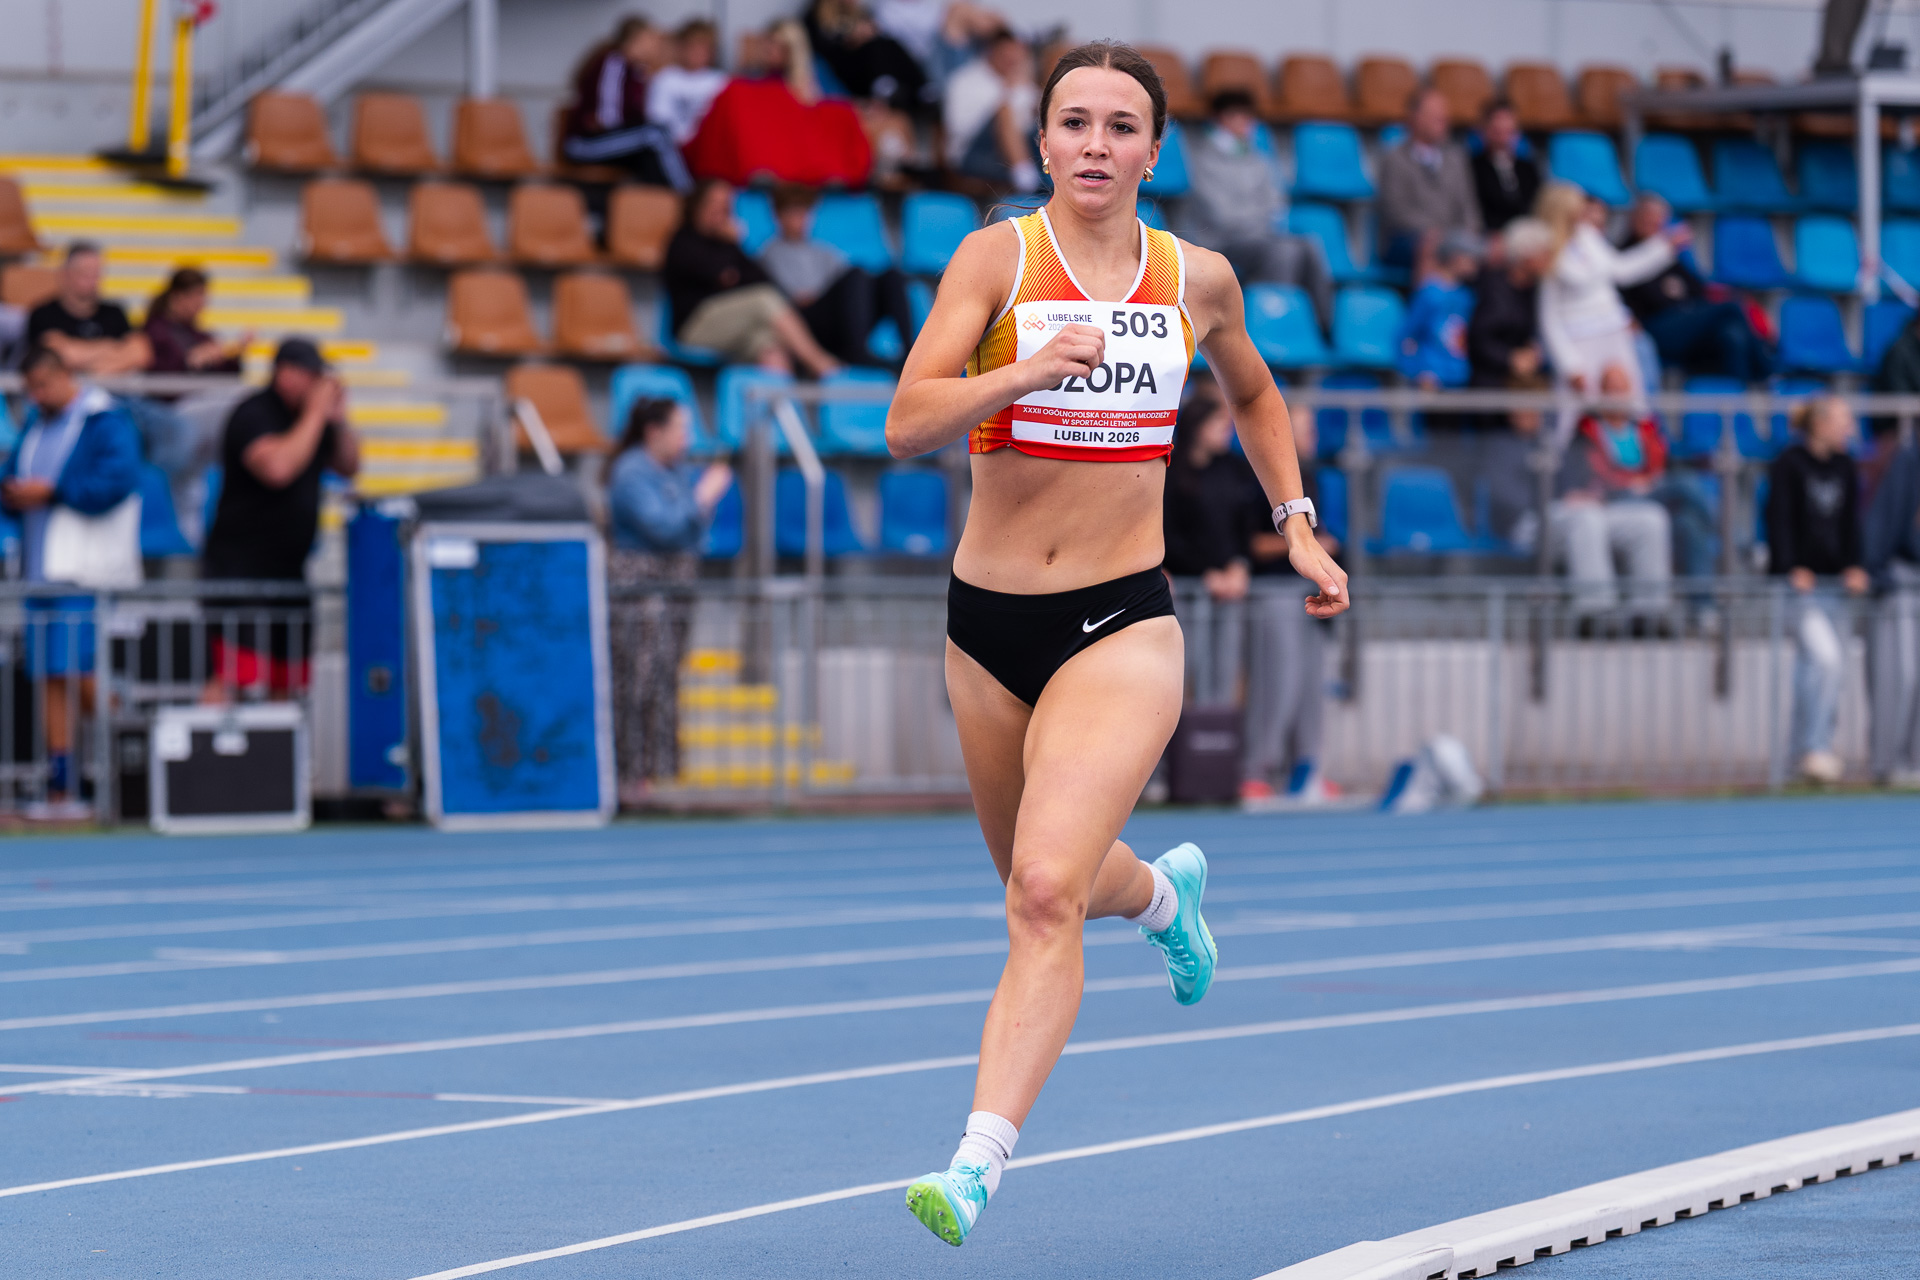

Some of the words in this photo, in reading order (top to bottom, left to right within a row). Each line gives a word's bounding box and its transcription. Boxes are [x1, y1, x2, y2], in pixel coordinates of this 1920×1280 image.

[1047, 313, 1093, 322] LUBELSKIE
[1111, 310, 1168, 338] 503
[1048, 362, 1157, 394] ZOPA
[1023, 406, 1042, 414] XXXII
[1042, 409, 1100, 418] OGÓLNOPOLSKA
[1138, 411, 1171, 419] MŁODZIEŻY
[1054, 429, 1104, 442] LUBLIN
[1107, 431, 1140, 443] 2026
